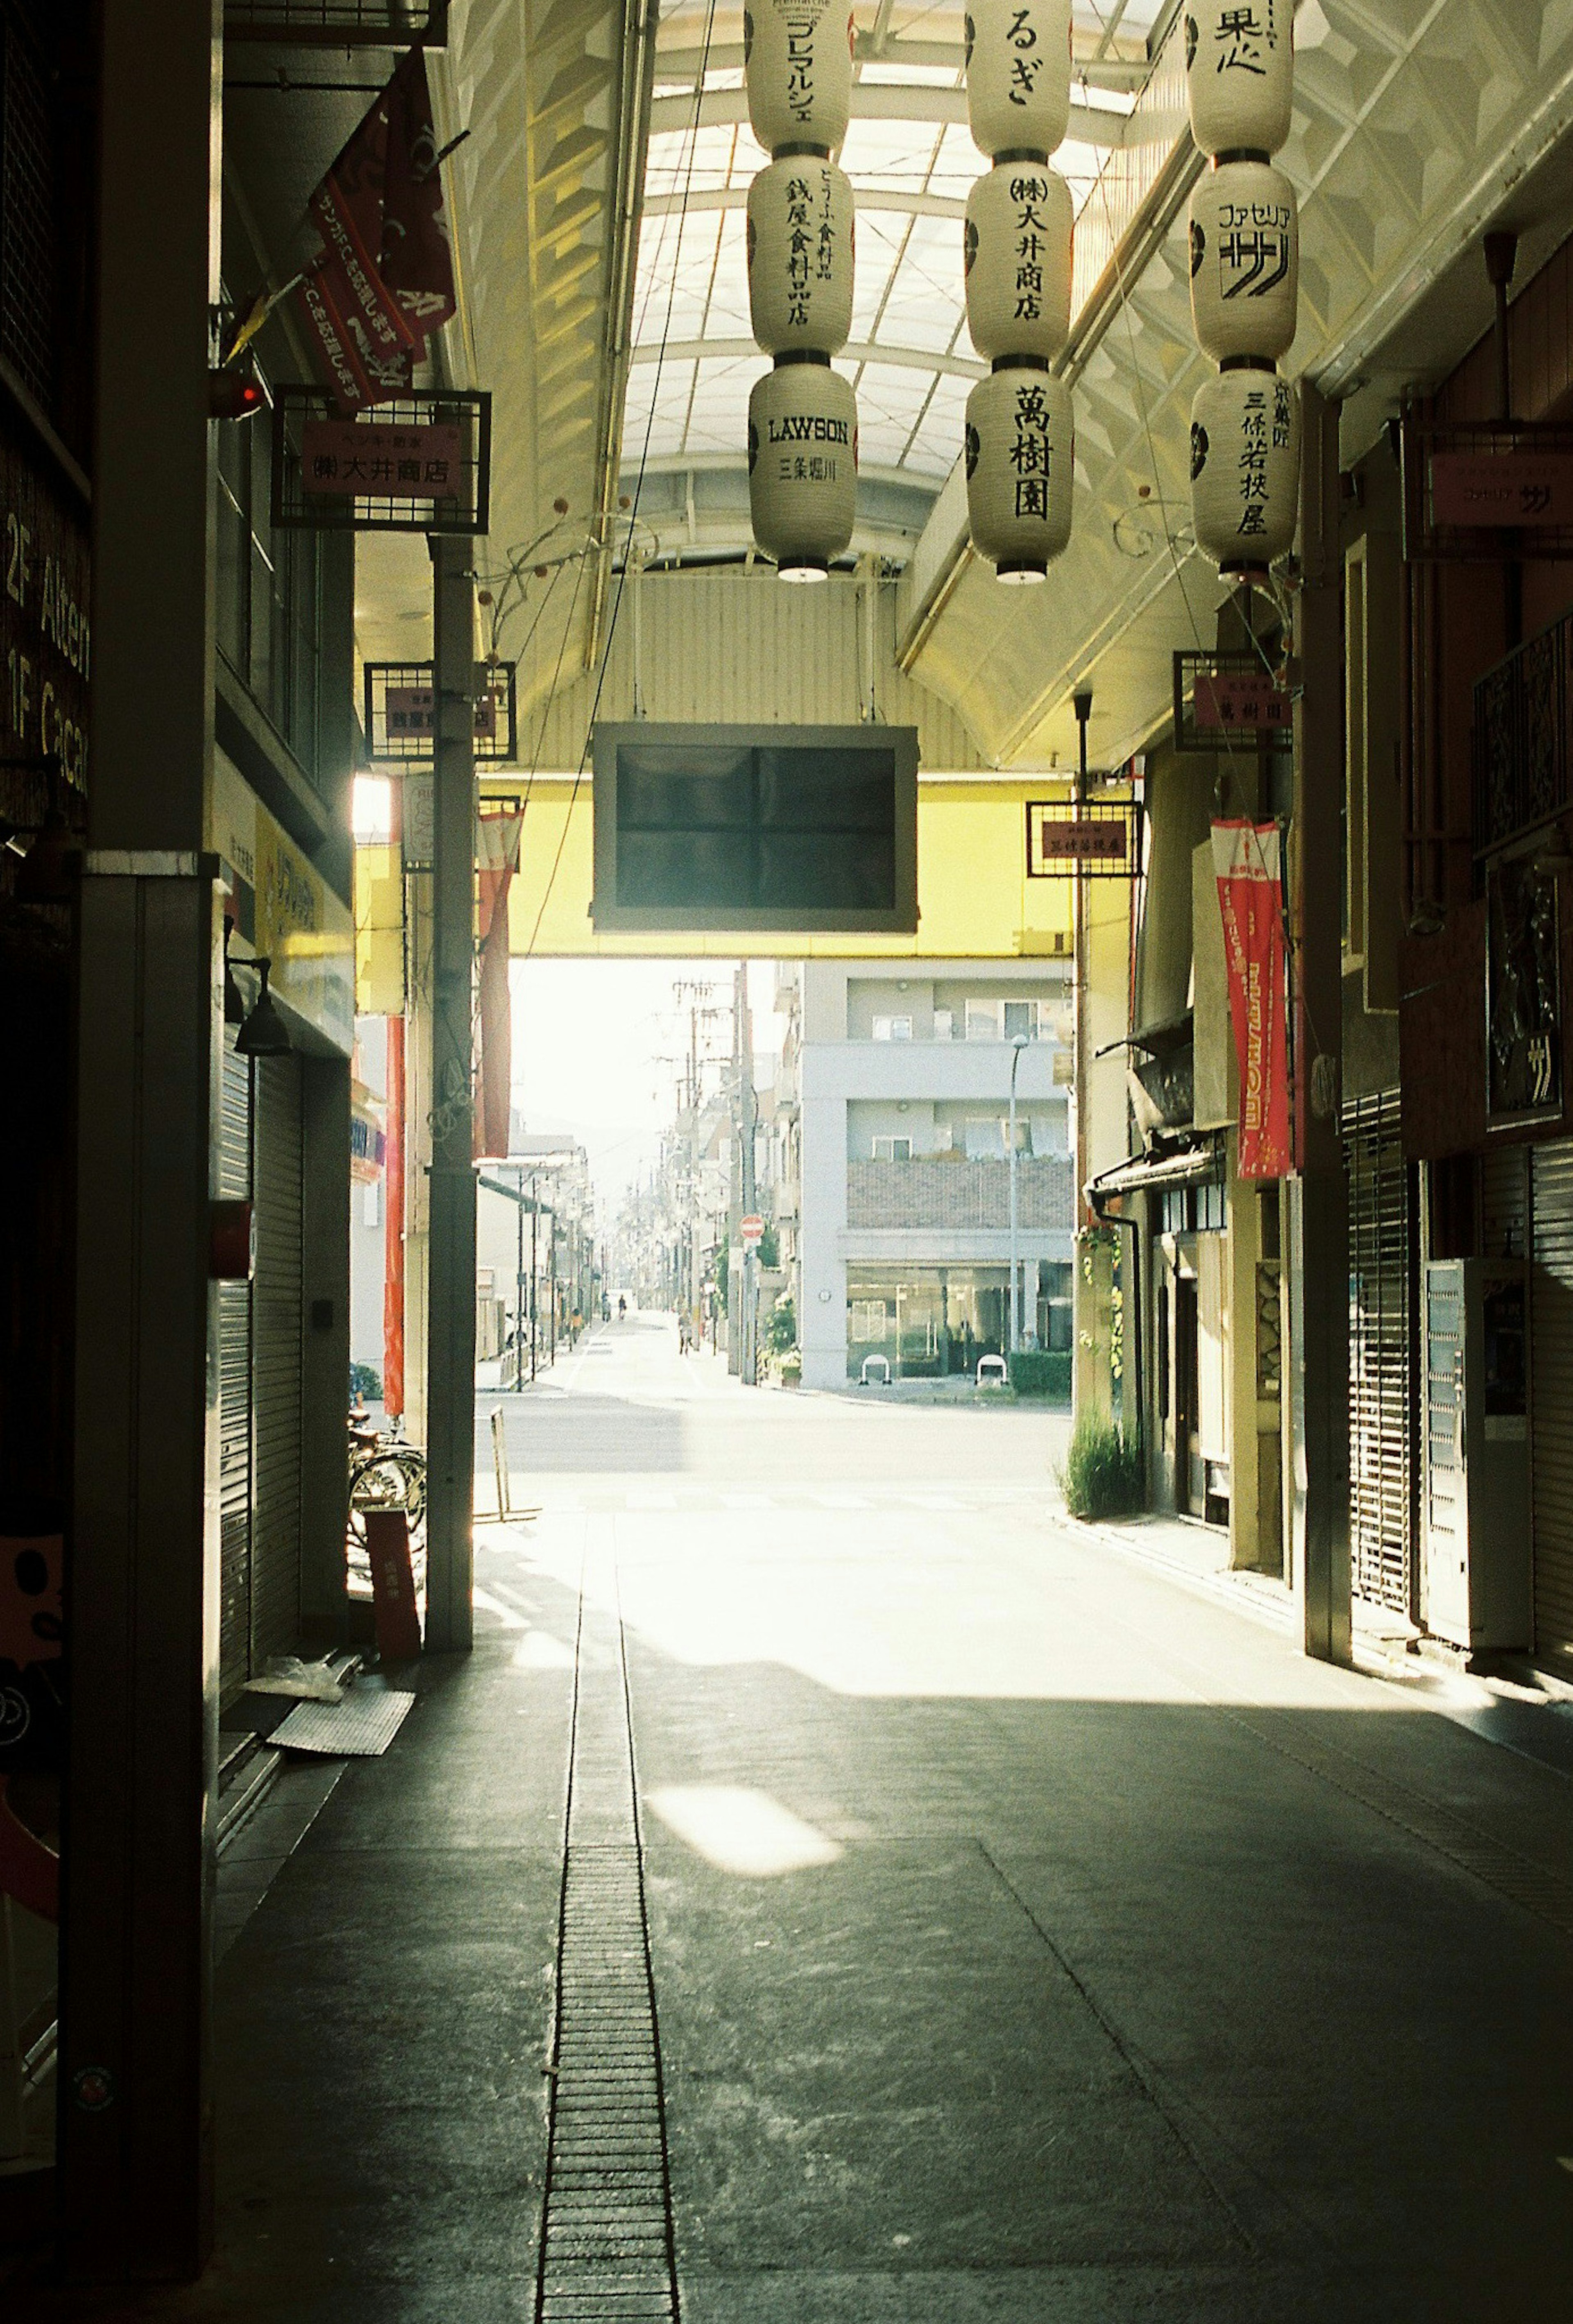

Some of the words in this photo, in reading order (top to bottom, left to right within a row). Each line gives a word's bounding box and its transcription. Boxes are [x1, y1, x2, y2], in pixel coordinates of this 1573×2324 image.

[787, 19, 817, 122] プレマルシェ
[768, 416, 848, 445] LAWSON
[1010, 386, 1053, 521] 萬樹園
